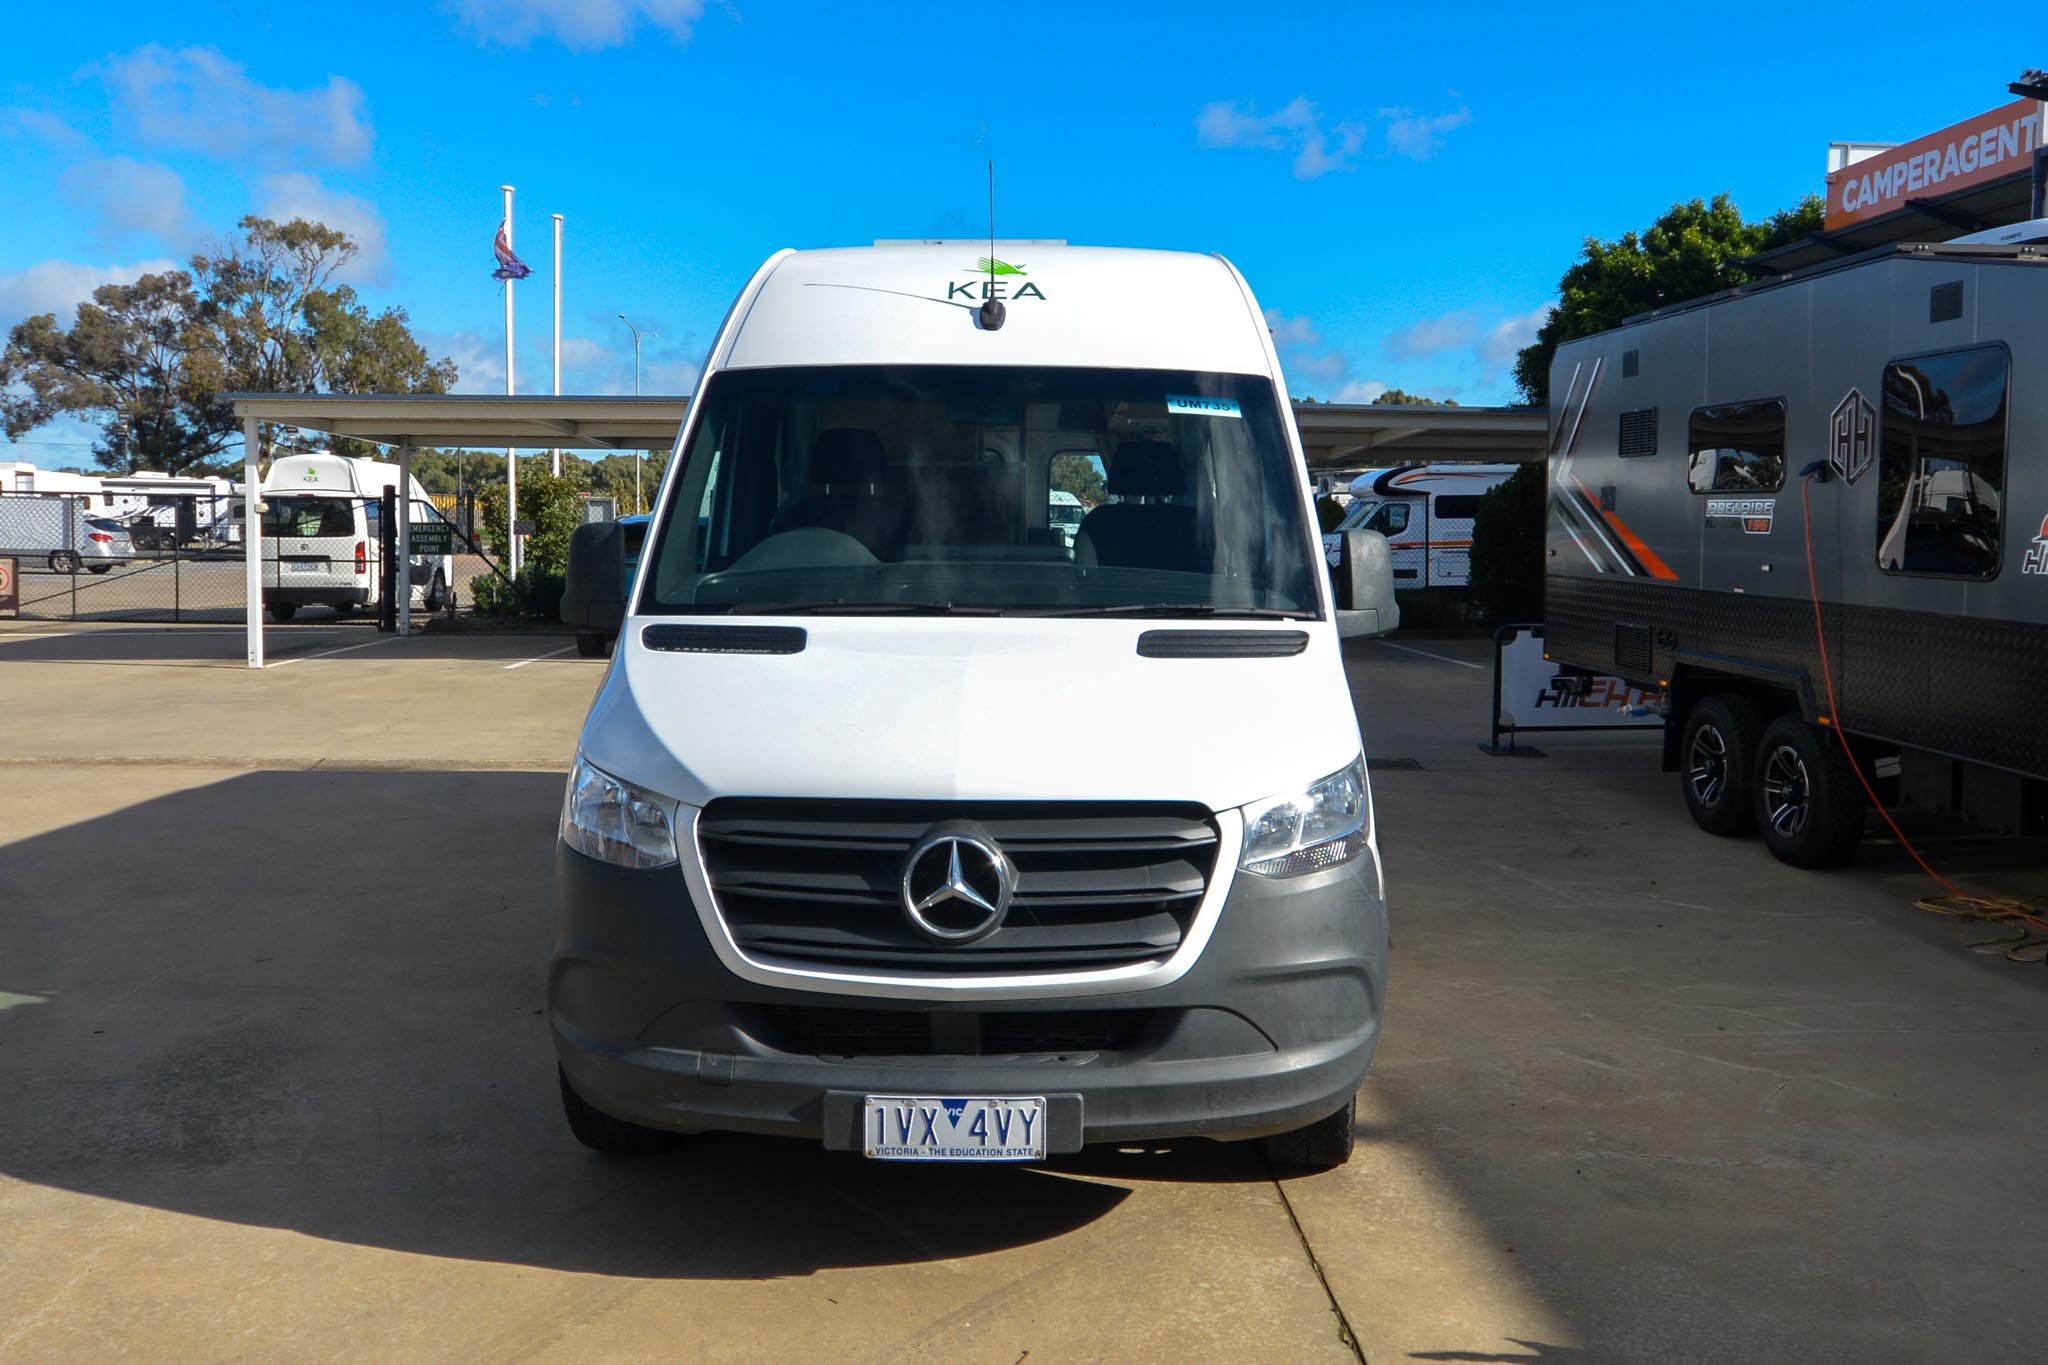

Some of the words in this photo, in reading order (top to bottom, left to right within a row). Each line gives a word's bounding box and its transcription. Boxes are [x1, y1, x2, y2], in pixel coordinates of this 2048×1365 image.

[1842, 112, 2039, 213] CAMPERAGENT
[947, 281, 1047, 301] KEA
[409, 524, 450, 533] EMERGENCY
[410, 534, 448, 543] ASSEMBLY
[419, 543, 441, 553] POINT
[875, 1107, 940, 1146] 1VX
[968, 1106, 1040, 1146] 4VY
[875, 1147, 919, 1156] VICTORIA
[929, 1148, 947, 1156] THE
[950, 1148, 1003, 1157] EDUCATION
[1006, 1148, 1034, 1157] STATE
